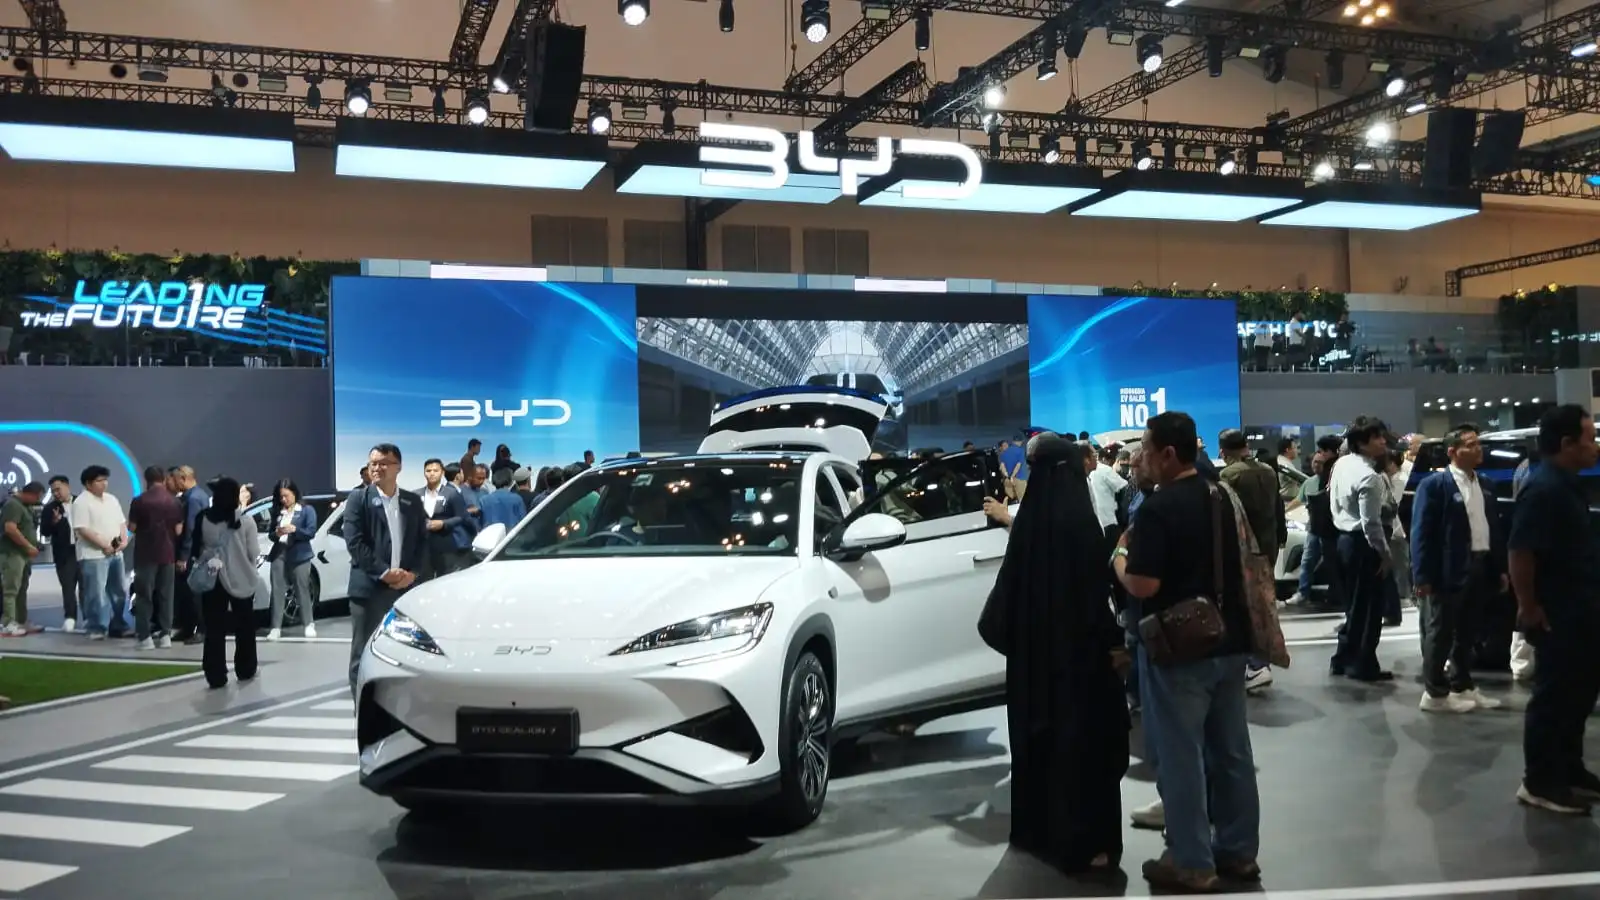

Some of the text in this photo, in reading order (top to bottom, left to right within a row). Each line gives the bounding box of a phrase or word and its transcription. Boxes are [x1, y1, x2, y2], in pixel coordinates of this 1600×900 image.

[700, 121, 982, 200] BYD
[20, 312, 65, 328] THE
[440, 399, 572, 427] BYD
[1150, 387, 1166, 416] 1
[494, 645, 552, 656] BYD
